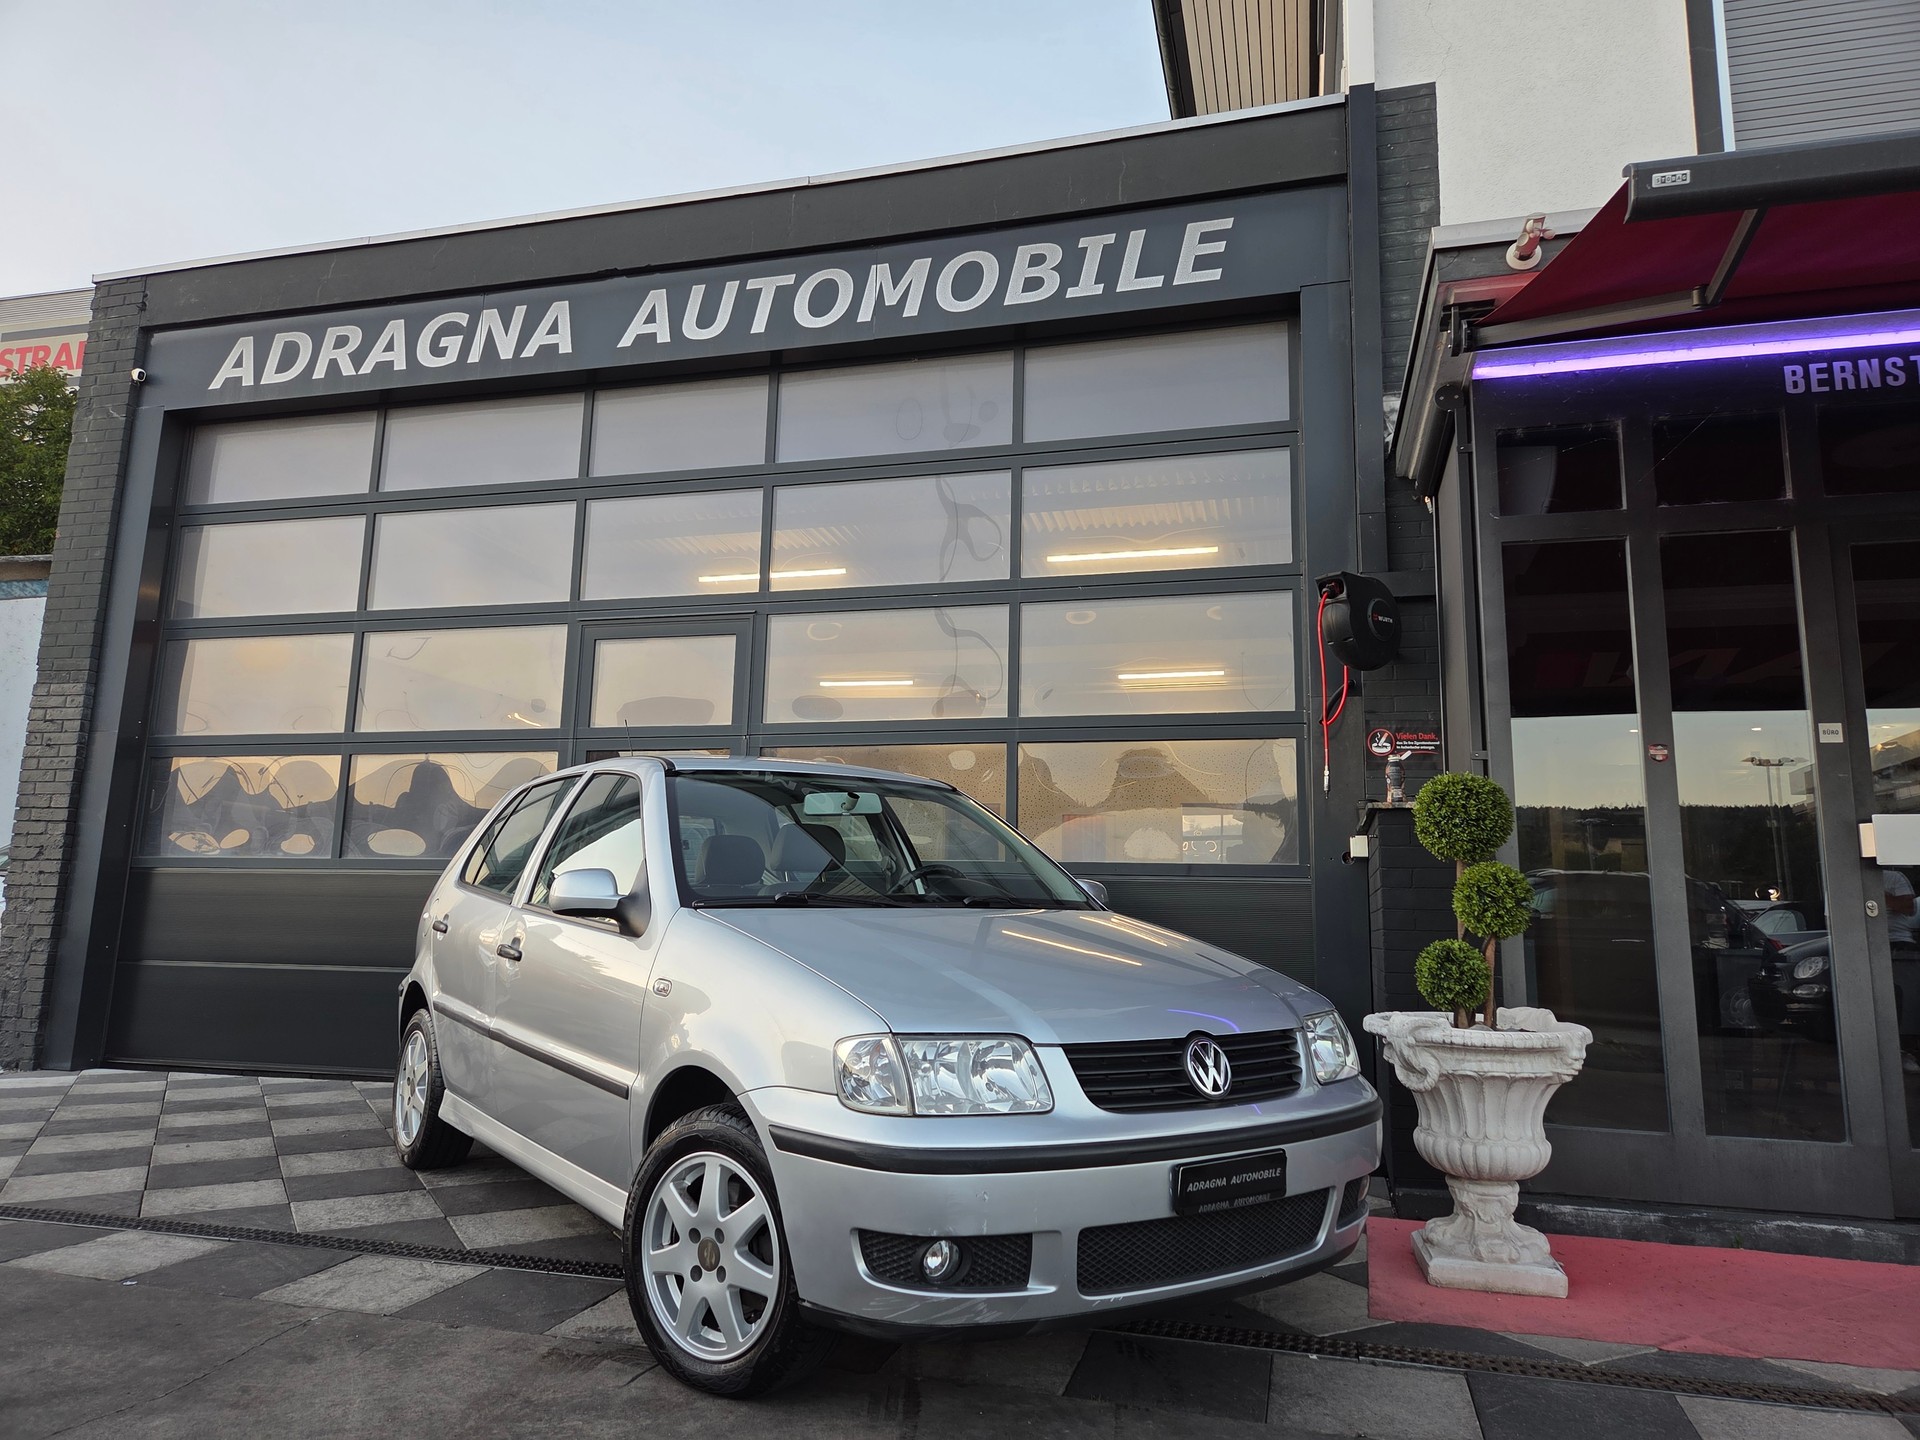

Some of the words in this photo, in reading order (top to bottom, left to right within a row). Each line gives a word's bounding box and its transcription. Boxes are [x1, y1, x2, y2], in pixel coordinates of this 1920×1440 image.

[208, 300, 573, 390] ADRAGNA
[616, 217, 1235, 348] AUTOMOBILE
[1395, 732, 1417, 740] Vielen
[1822, 728, 1840, 736] BÜRO
[1186, 1177, 1227, 1193] ADRAGNA
[1230, 1168, 1281, 1185] AUTOMOBILE
